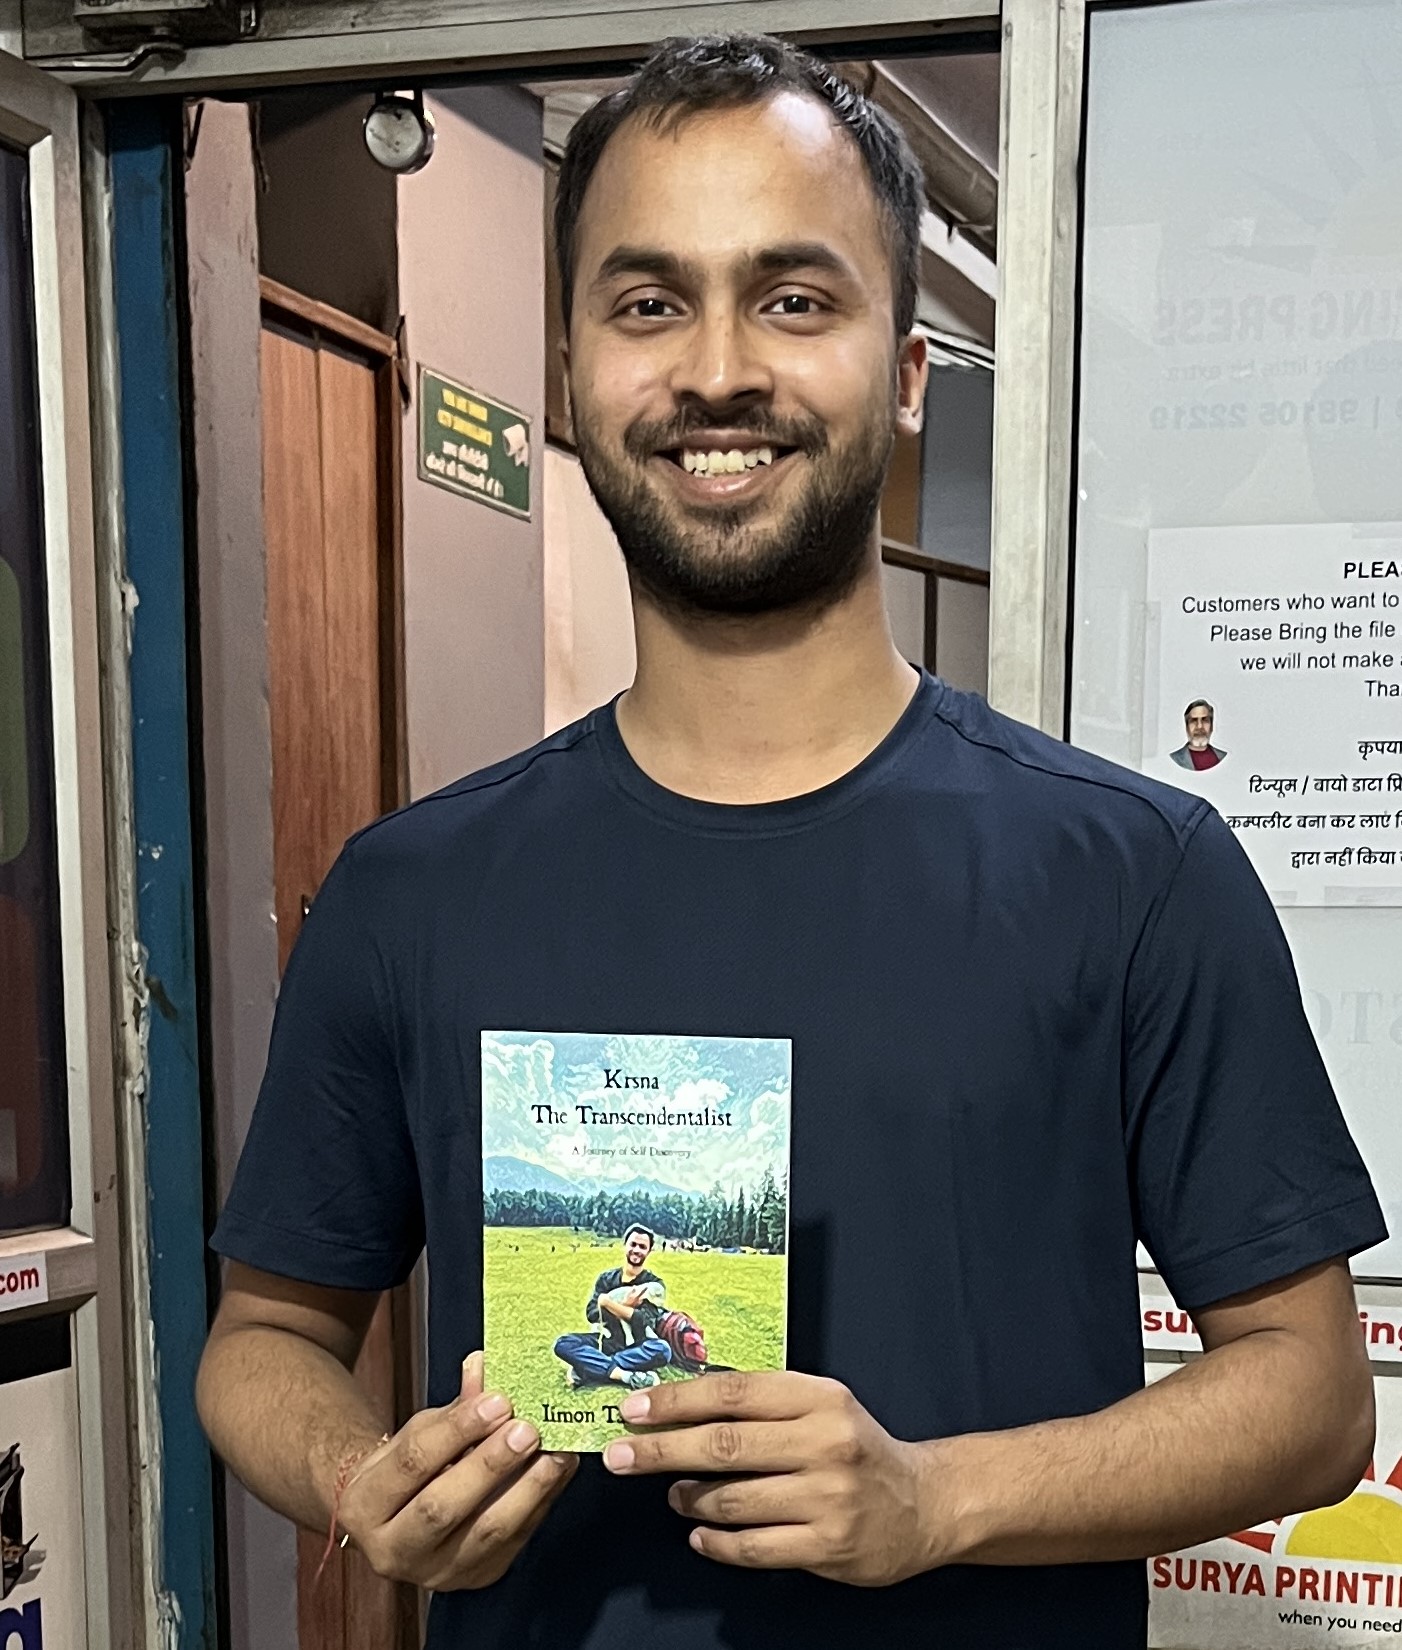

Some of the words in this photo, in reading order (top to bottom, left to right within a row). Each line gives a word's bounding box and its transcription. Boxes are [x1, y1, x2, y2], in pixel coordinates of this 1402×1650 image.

[1343, 560, 1402, 579] PLEA
[1182, 596, 1280, 613] Customers
[1287, 593, 1325, 610] who
[1331, 592, 1376, 609] want
[1382, 591, 1400, 608] to
[1211, 624, 1272, 642] Please
[1279, 622, 1327, 643] Bring
[1334, 621, 1362, 639] the
[1369, 620, 1396, 638] file
[1240, 656, 1266, 671] we
[1272, 652, 1301, 670] will
[1307, 652, 1336, 669] not
[1342, 651, 1394, 668] make
[1364, 680, 1402, 697] Tha
[1249, 774, 1298, 798] रिज्यूम
[1351, 777, 1383, 792] डाटा
[1226, 810, 1292, 829] कम्पलीट
[1329, 814, 1356, 829] कर
[1359, 810, 1391, 829] लाएं
[1290, 851, 1321, 869] द्वारा
[1324, 846, 1355, 867] नहीं
[1356, 846, 1396, 865] किया
[603, 1068, 660, 1090] Krsna
[531, 1104, 568, 1125] The
[575, 1104, 733, 1126] Transcendentalist
[571, 1146, 580, 1155] A
[581, 1144, 616, 1158] Journey
[618, 1145, 628, 1156] of
[630, 1145, 647, 1156] Self
[1144, 1310, 1198, 1334] su
[1153, 1555, 1266, 1597] SURYA
[1275, 1565, 1402, 1609] PRINTI
[1278, 1609, 1322, 1627] when
[1327, 1616, 1357, 1632] you
[1363, 1618, 1402, 1633] need
